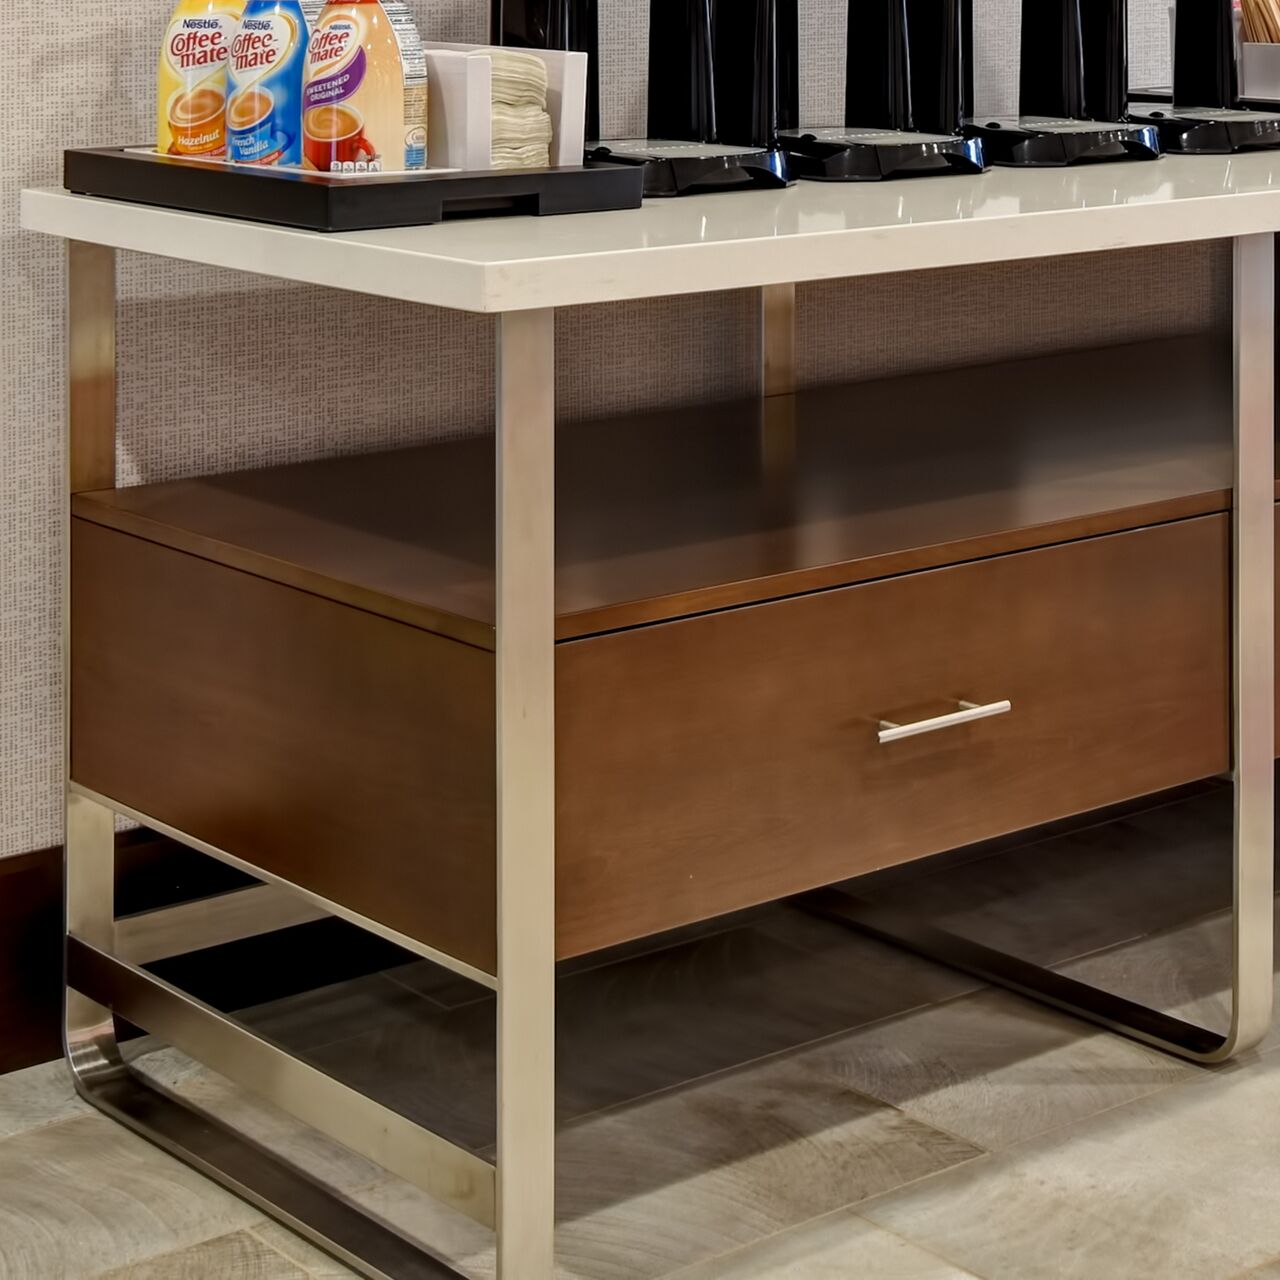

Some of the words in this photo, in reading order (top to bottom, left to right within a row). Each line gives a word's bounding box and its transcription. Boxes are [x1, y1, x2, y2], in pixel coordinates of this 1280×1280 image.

[180, 46, 228, 69] mate
[235, 48, 276, 71] mate
[310, 46, 344, 65] mate
[306, 73, 350, 96] SWEETENED
[309, 86, 345, 102] ORIGINAL
[177, 129, 220, 145] Hazelnut
[239, 140, 269, 156] Vanilla
